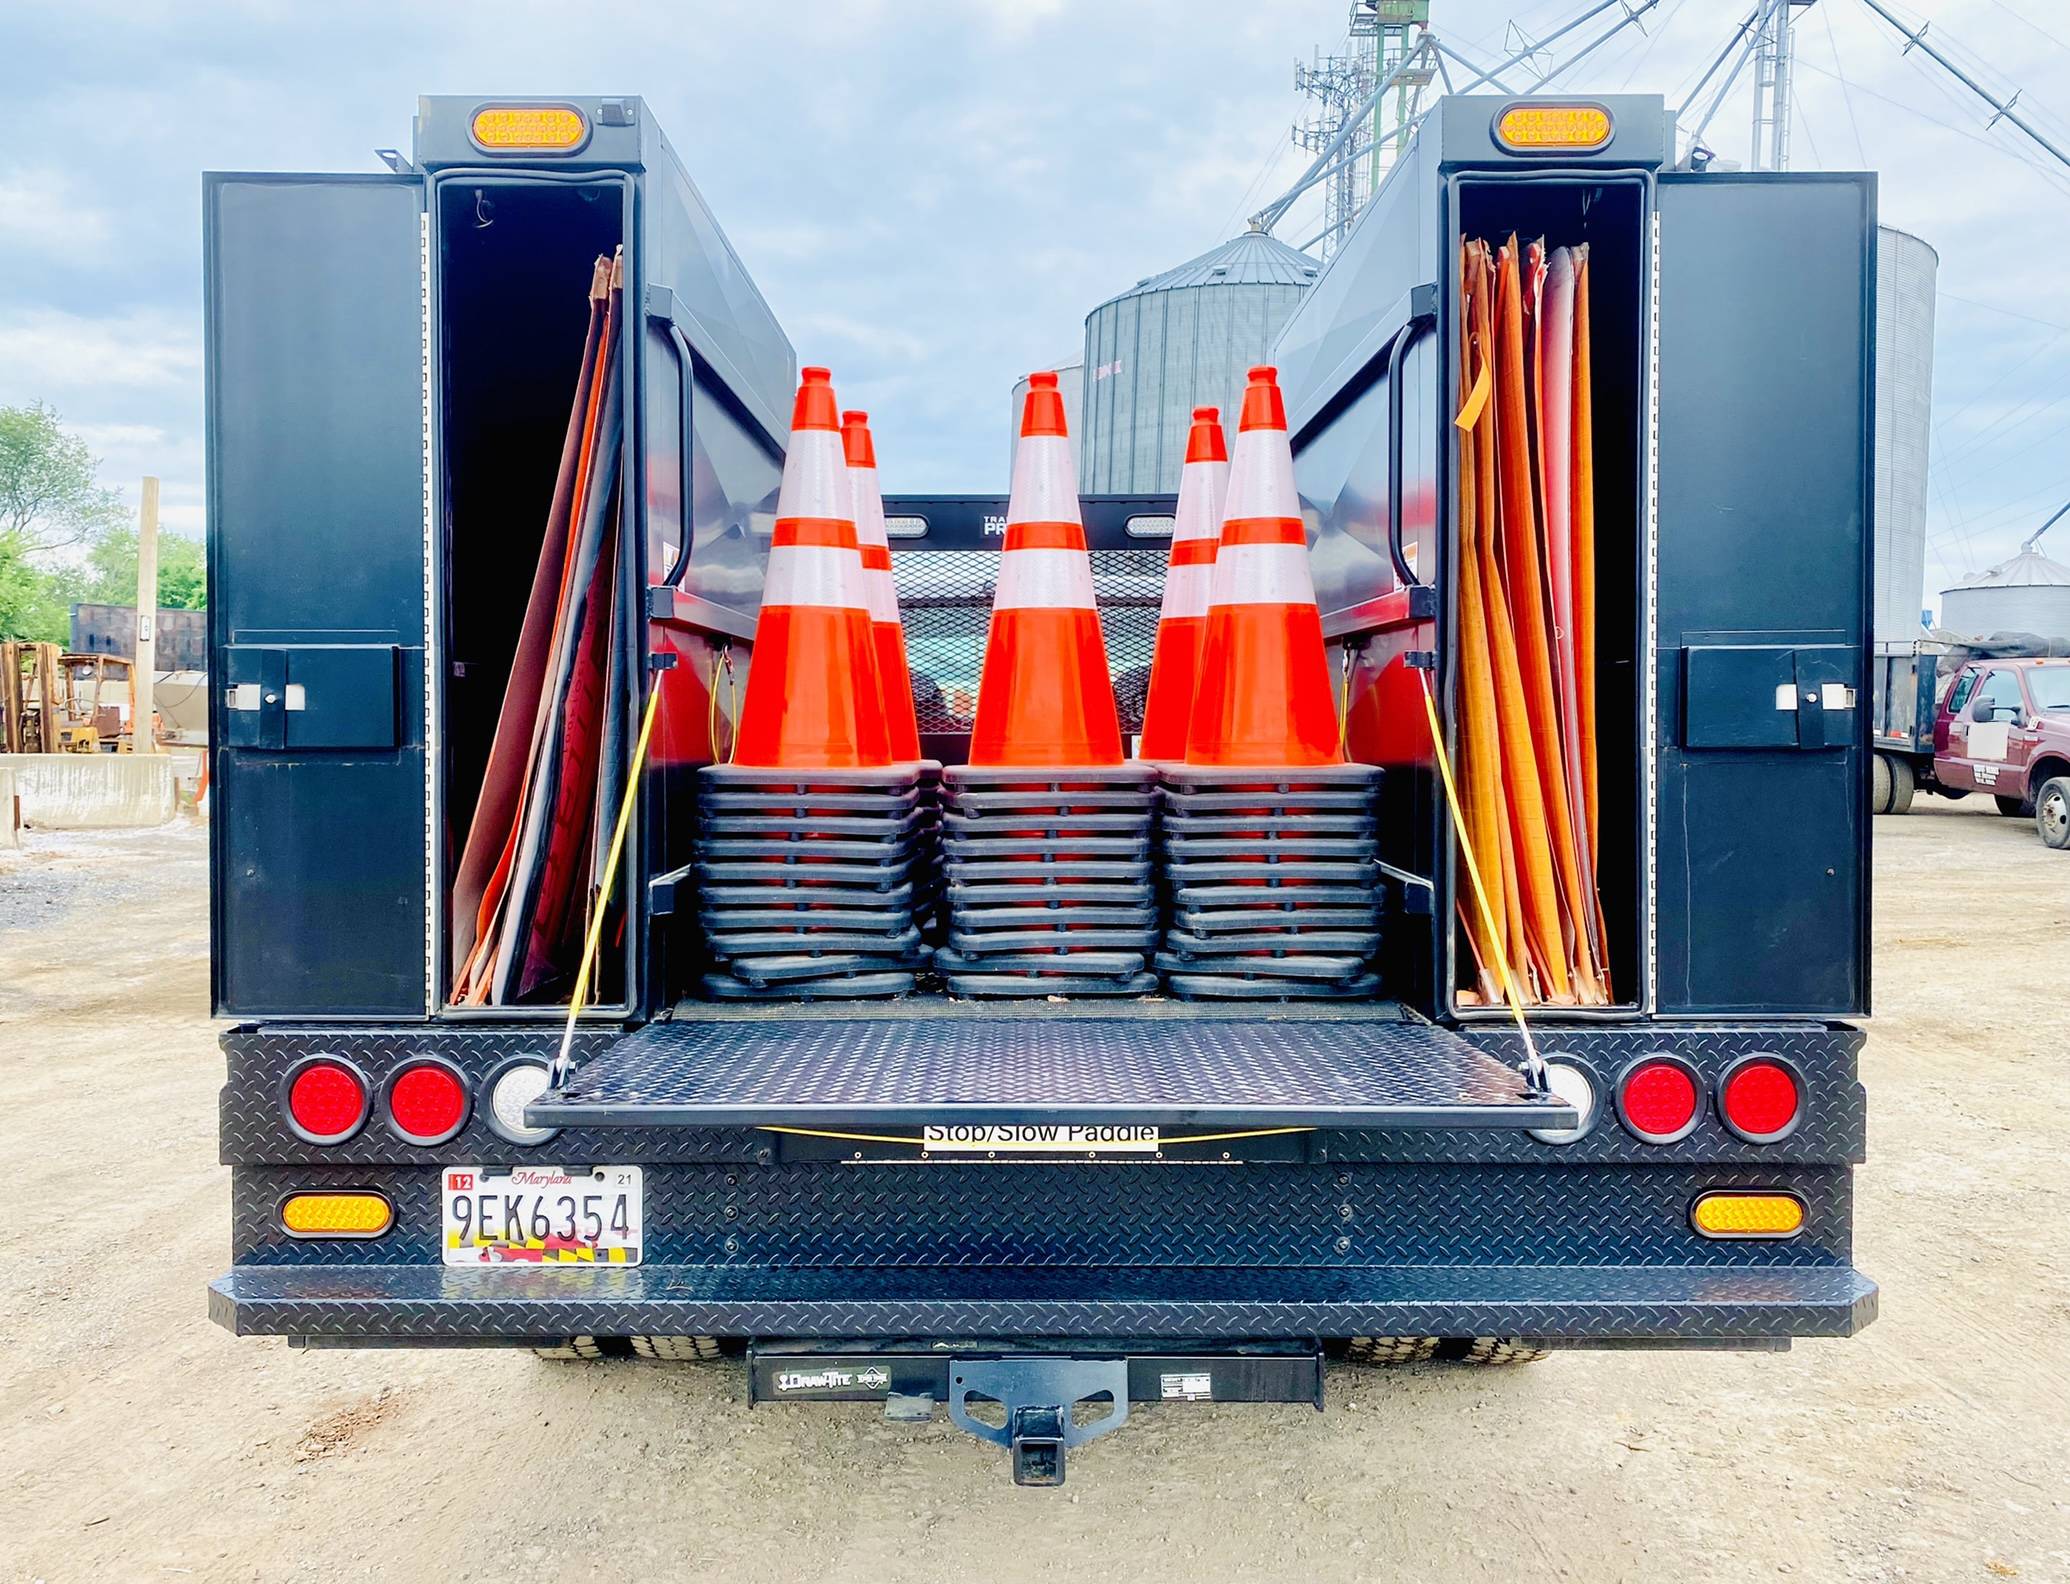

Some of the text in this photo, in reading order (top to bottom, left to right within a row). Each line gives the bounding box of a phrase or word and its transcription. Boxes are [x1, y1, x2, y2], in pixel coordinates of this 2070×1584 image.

[983, 515, 1007, 523] TRA
[984, 523, 1006, 535] PR
[928, 1126, 1155, 1143] Stop/Slow Paddle
[455, 1176, 472, 1189] 12
[617, 1174, 632, 1185] 21
[452, 1194, 630, 1241] 9EK6354
